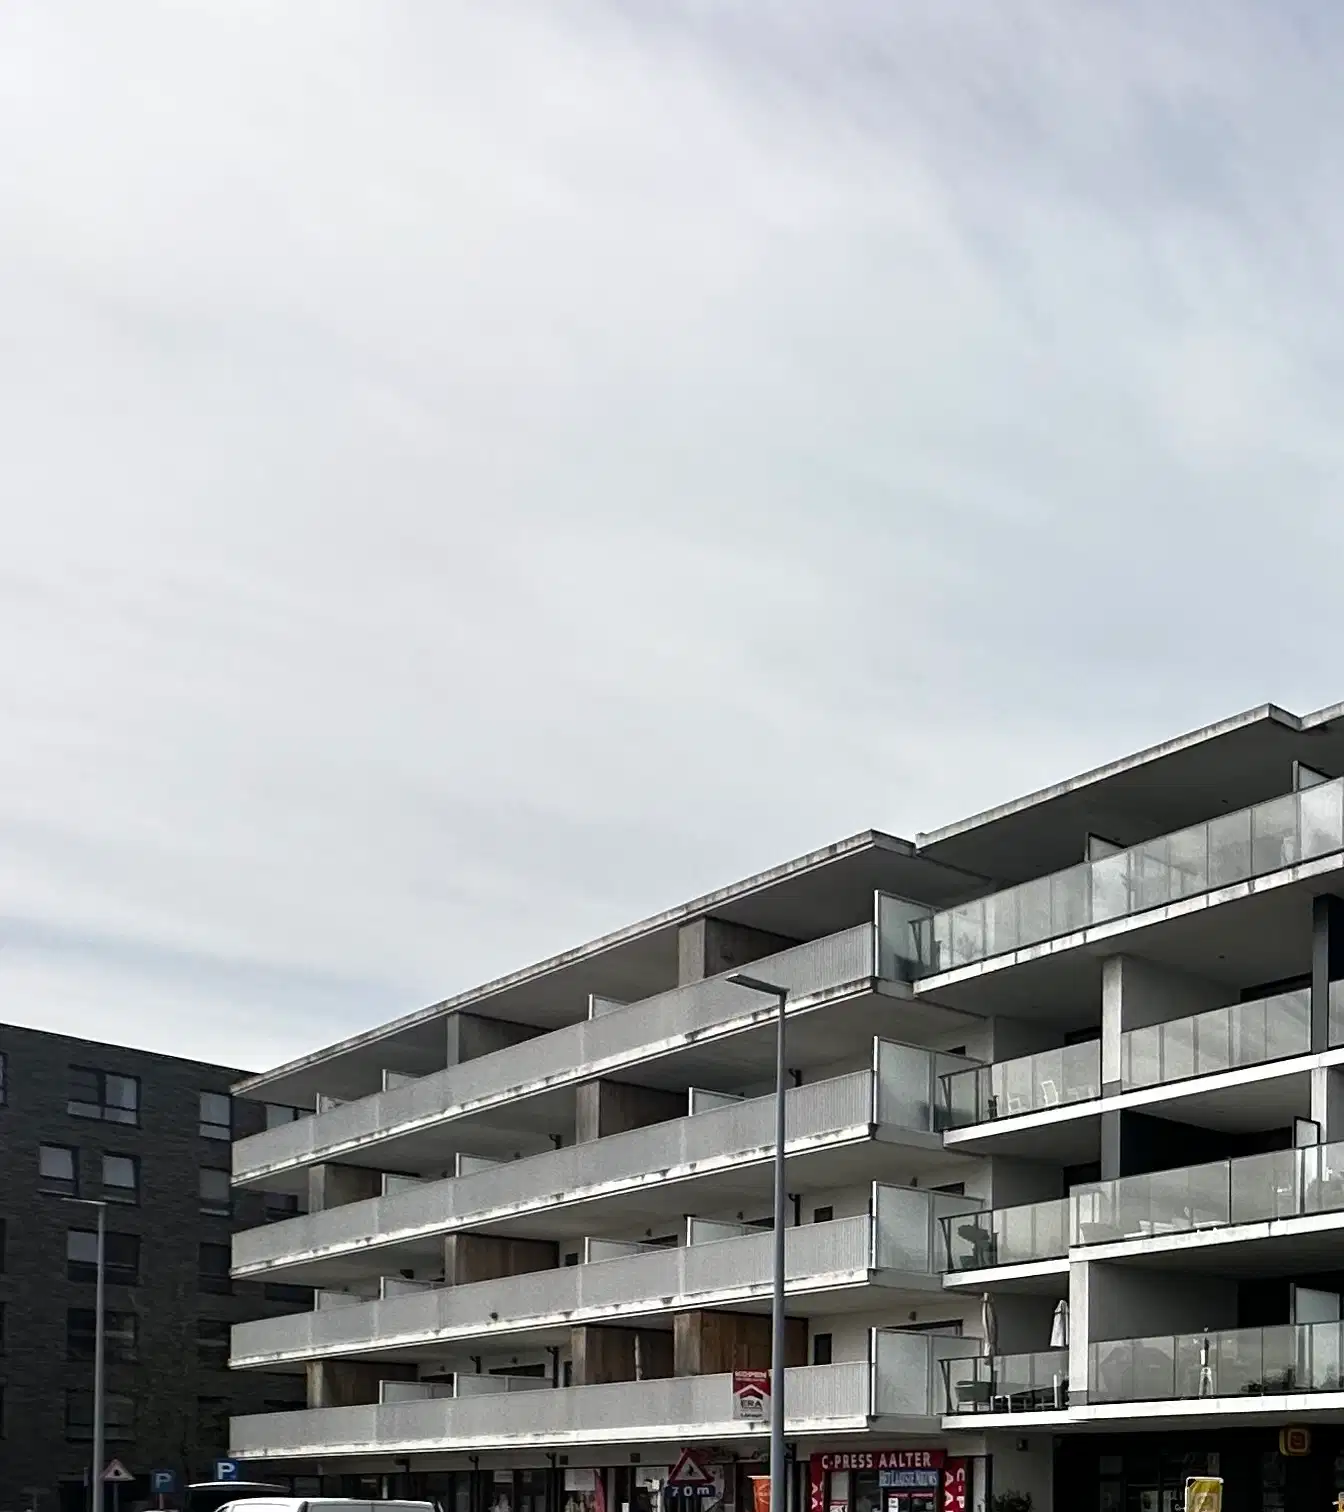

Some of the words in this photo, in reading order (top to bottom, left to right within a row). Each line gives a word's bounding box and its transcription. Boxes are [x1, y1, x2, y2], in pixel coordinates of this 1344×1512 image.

[821, 1453, 873, 1469] C-PRESS
[878, 1451, 931, 1468] AALTER
[217, 1462, 235, 1480] P
[155, 1472, 172, 1489] P
